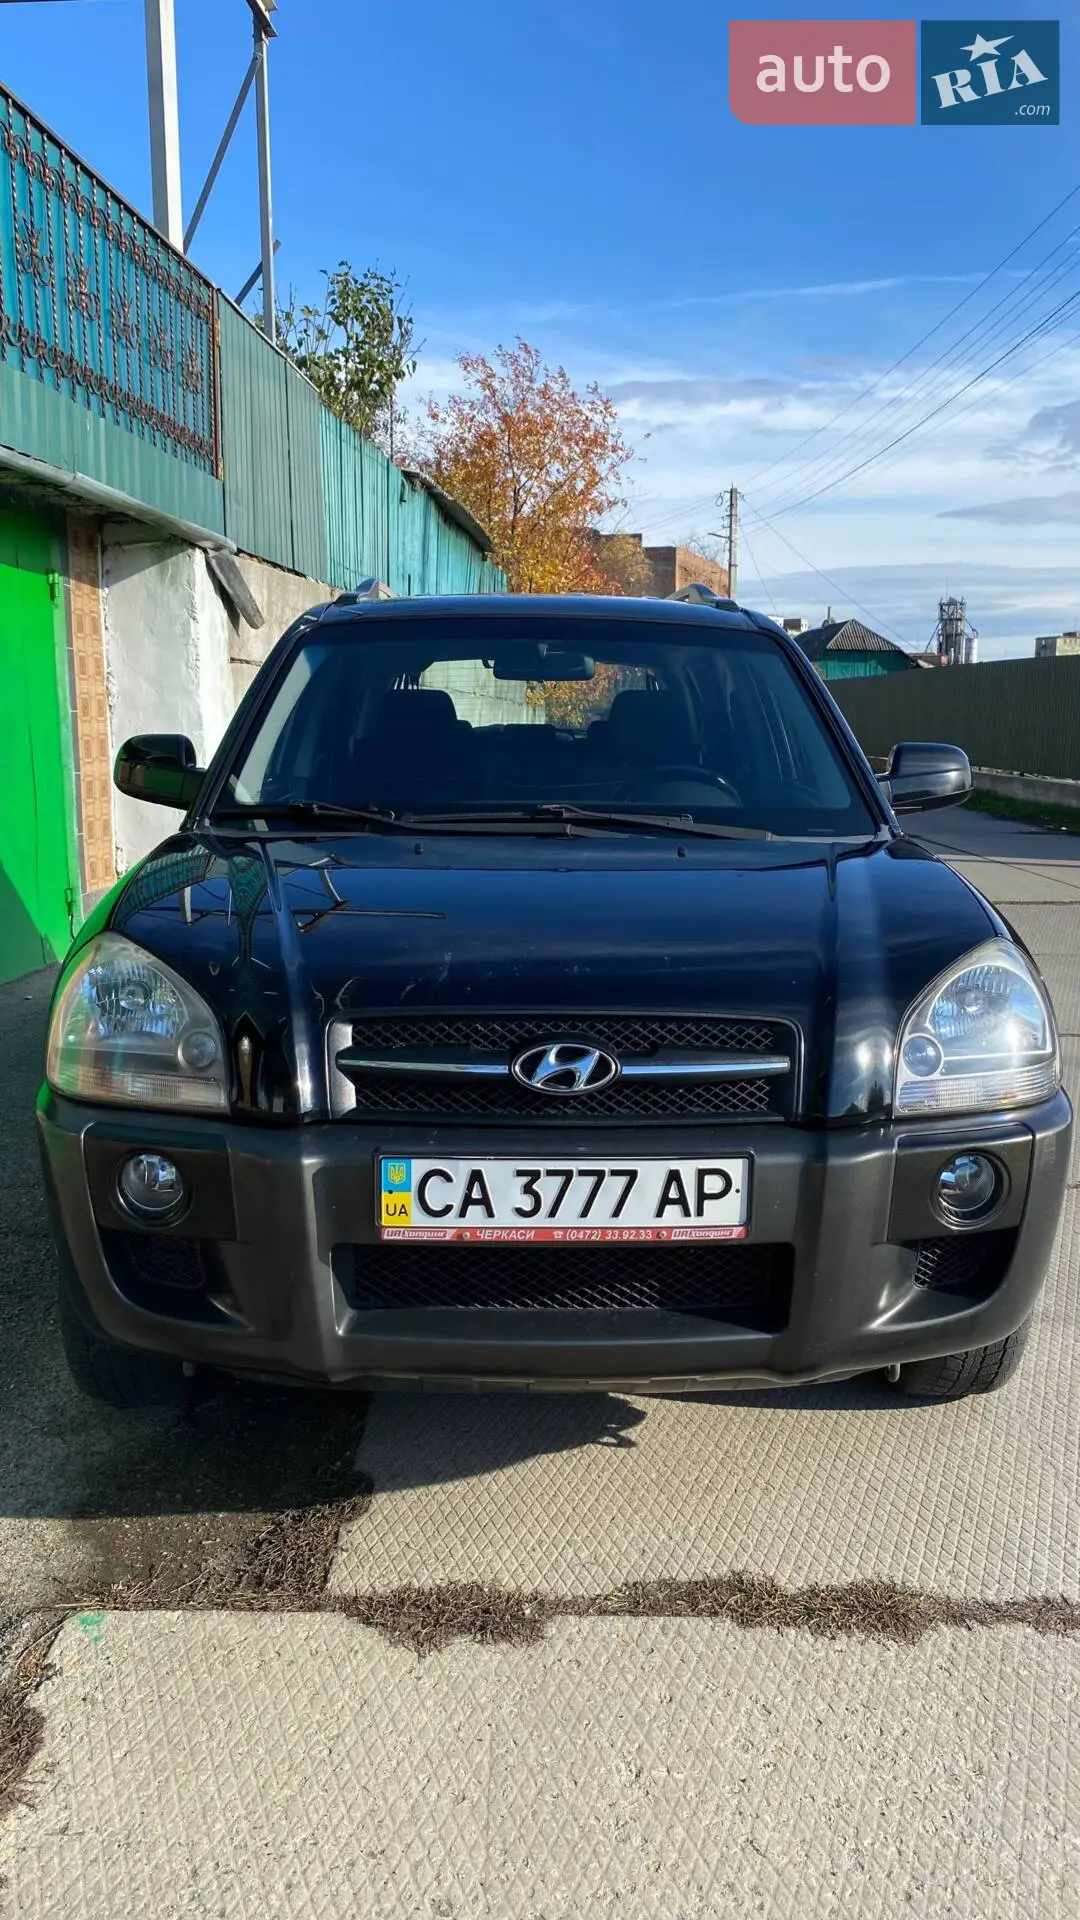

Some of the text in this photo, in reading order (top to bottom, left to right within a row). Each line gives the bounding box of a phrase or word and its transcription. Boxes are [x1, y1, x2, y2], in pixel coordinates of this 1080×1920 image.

[417, 1168, 733, 1219] CA 3777 AP
[385, 1203, 409, 1217] UA
[476, 1230, 536, 1240] ЧЕРКАСИ
[566, 1230, 652, 1241] (0472) 33.92.33
